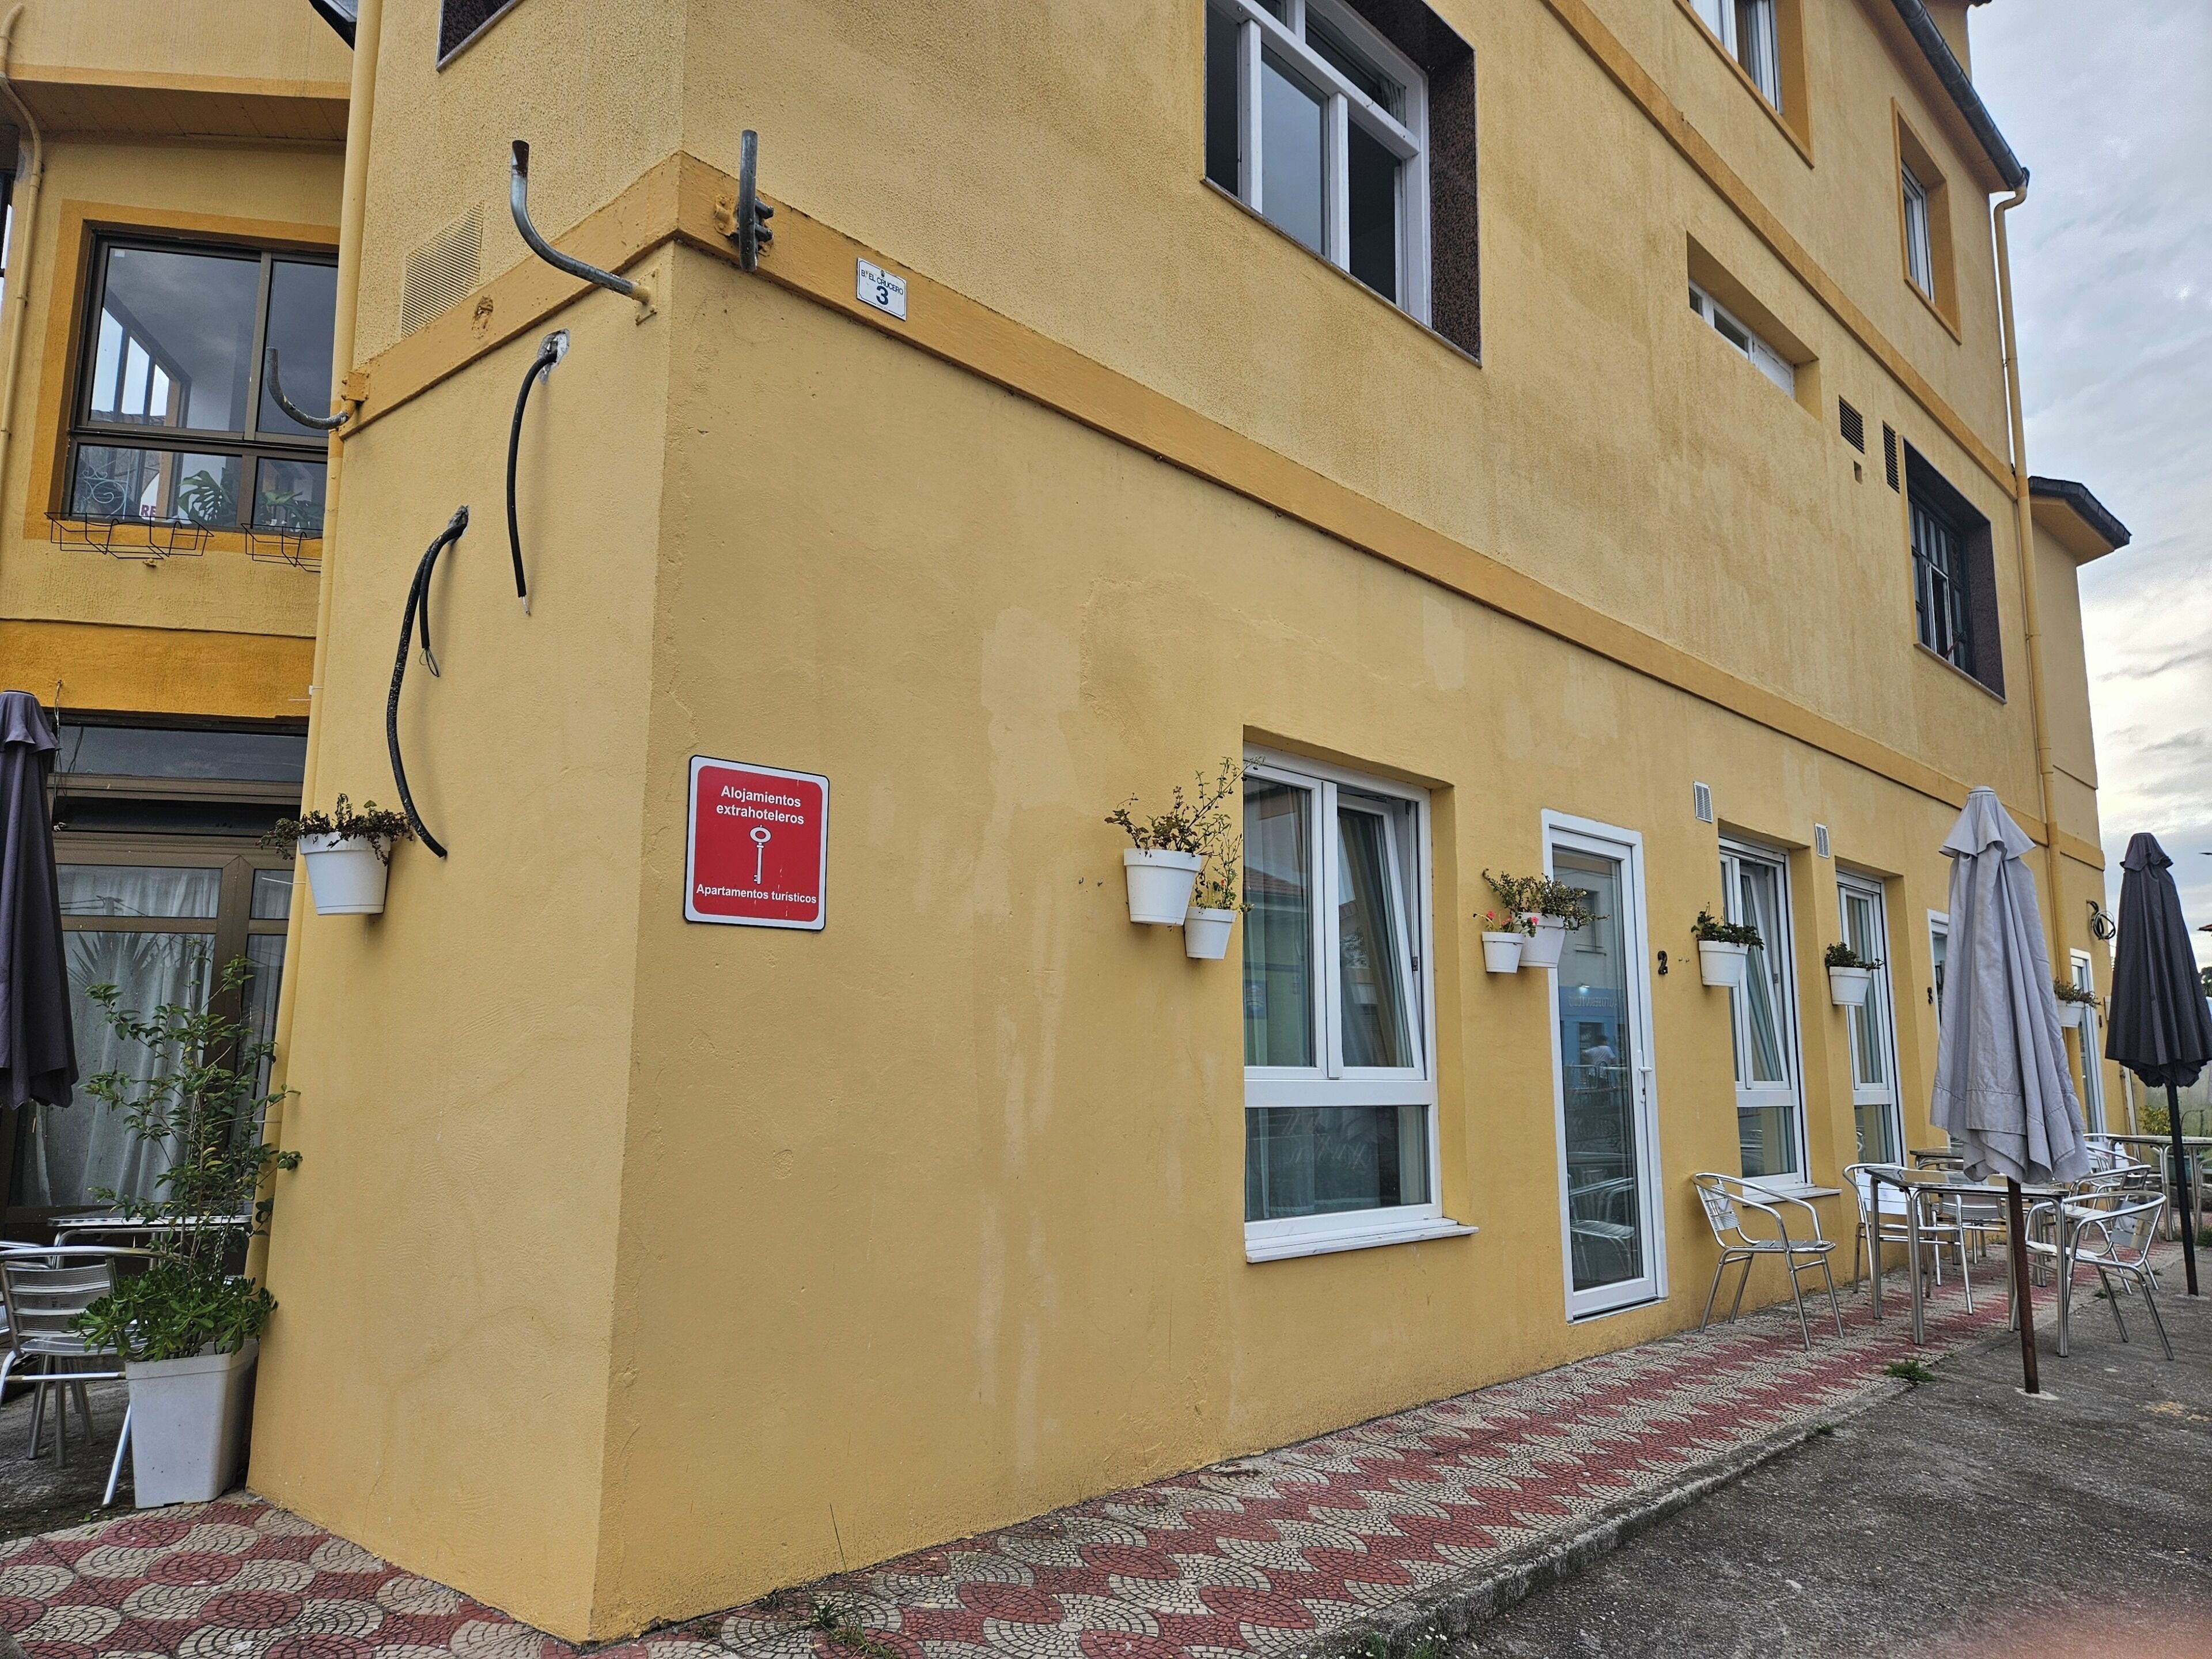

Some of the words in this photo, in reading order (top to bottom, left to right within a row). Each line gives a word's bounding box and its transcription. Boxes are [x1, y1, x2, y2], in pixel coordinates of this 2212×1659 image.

[869, 272, 876, 282] EL
[877, 277, 903, 296] CRUCERO
[876, 285, 889, 305] 3
[721, 785, 801, 808] Alojamientos
[716, 804, 804, 825] extrahoteleros
[696, 884, 768, 900] Apartamentos
[771, 891, 817, 904] turísticos
[1657, 950, 1668, 975] 2
